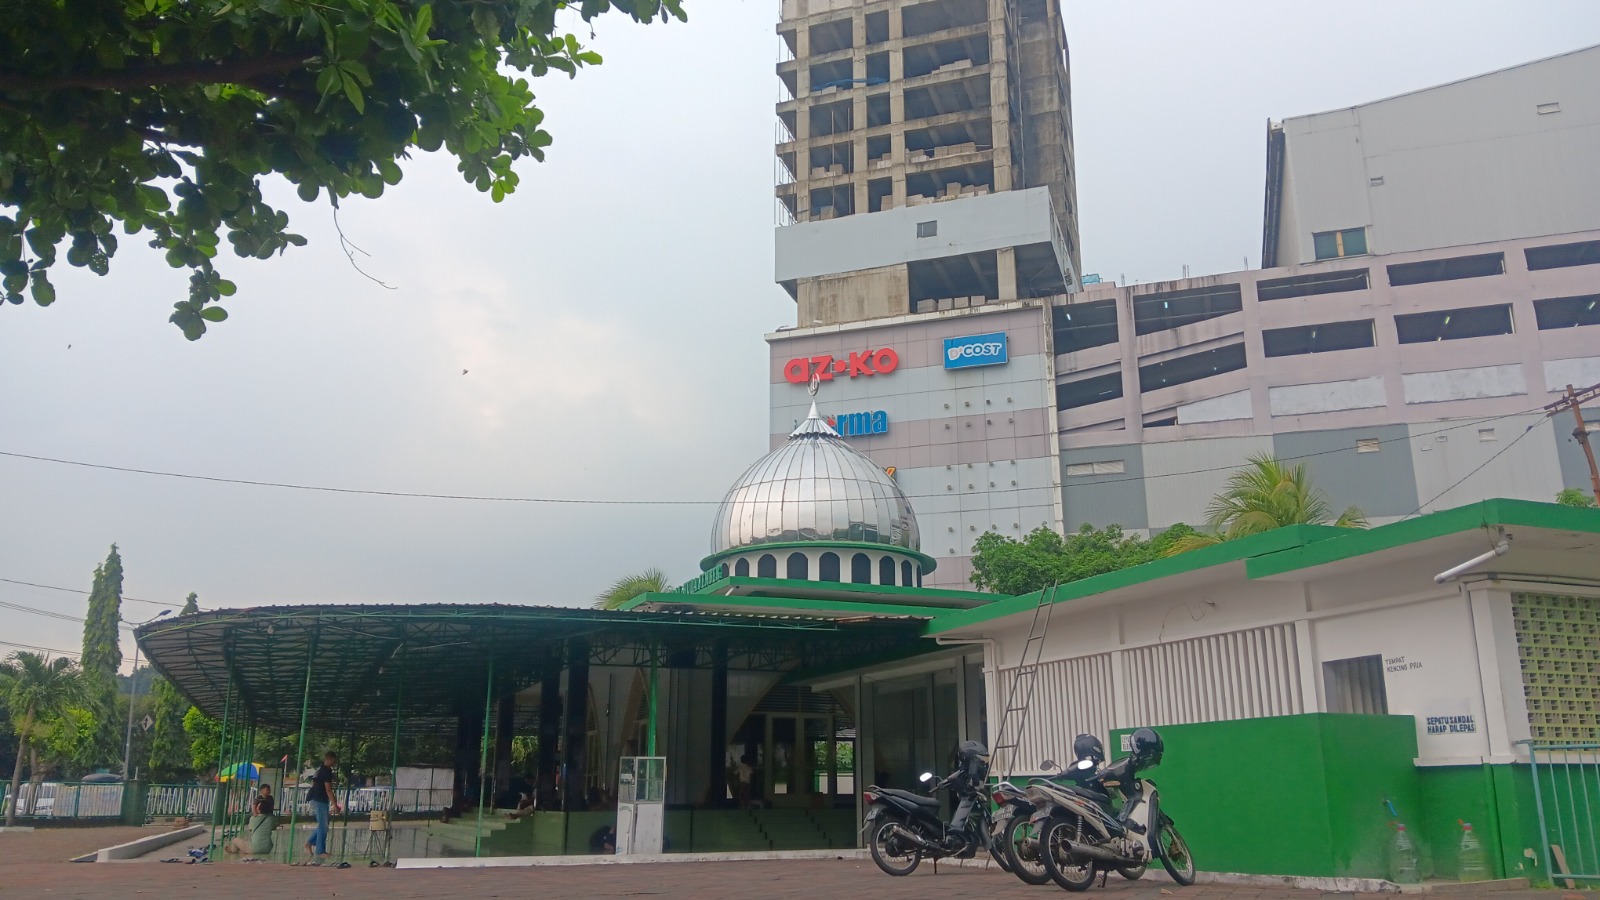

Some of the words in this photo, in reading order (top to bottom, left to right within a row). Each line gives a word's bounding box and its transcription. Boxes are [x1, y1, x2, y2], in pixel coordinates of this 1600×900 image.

[828, 410, 888, 437] rma
[1385, 656, 1405, 664] TEMPAT
[1450, 715, 1474, 724] SANDAL
[1427, 725, 1447, 733] HARAP
[1450, 724, 1475, 733] DILEPAS
